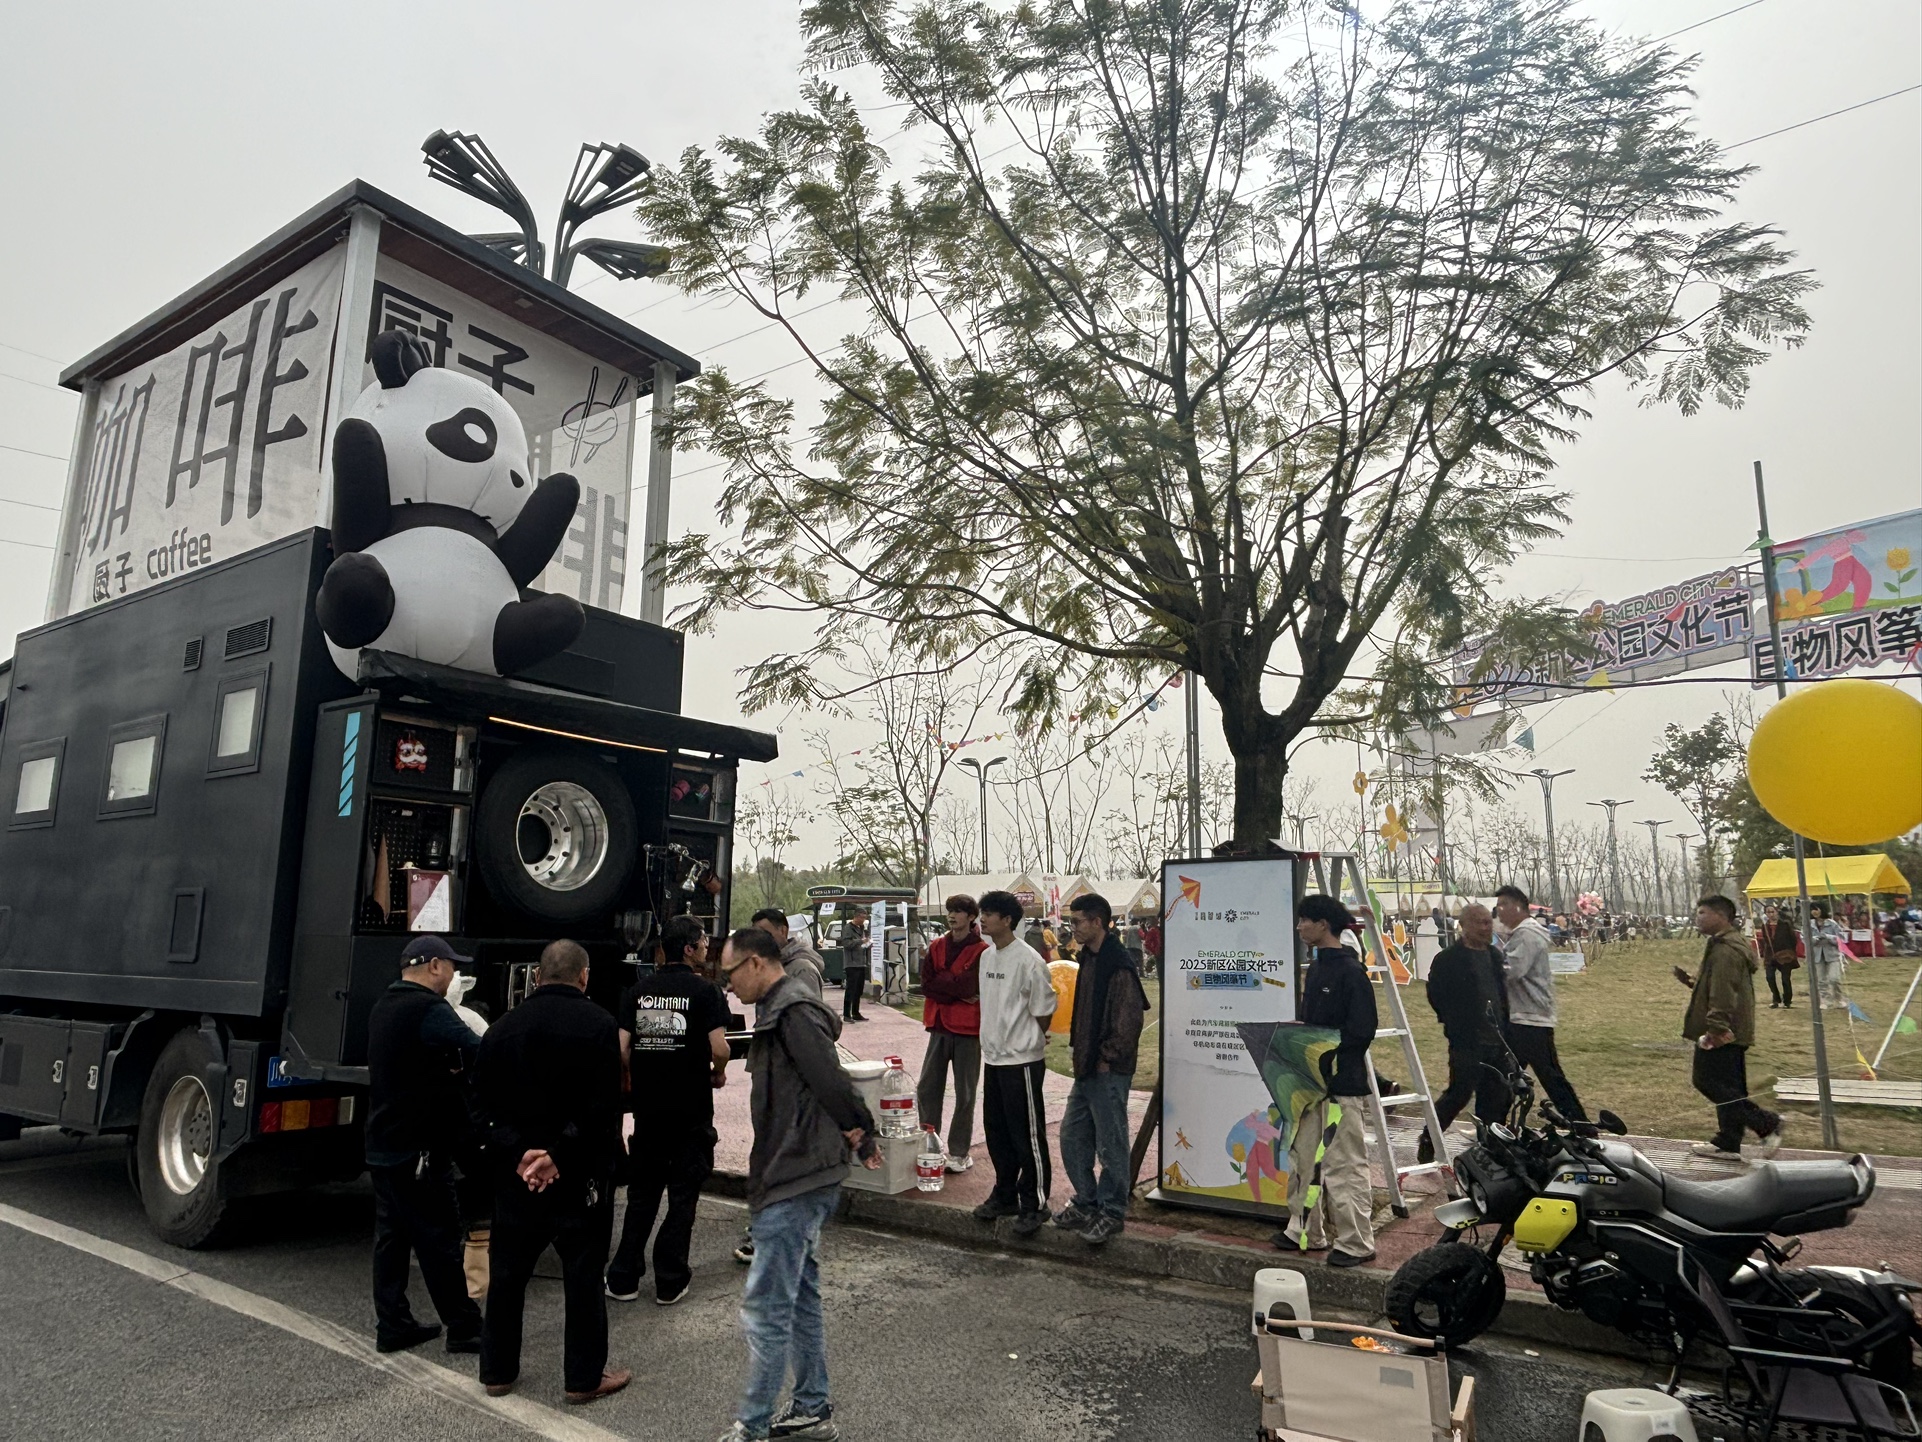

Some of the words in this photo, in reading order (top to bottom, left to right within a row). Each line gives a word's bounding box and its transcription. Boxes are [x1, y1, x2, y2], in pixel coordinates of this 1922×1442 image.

[92, 551, 133, 603] 厨子
[146, 526, 212, 580] coffee
[1603, 590, 1676, 624] EMERALD
[1679, 576, 1719, 602] CITY
[1180, 958, 1278, 972] 2025新区公园文化节
[1197, 950, 1236, 958] EMERALD
[1237, 950, 1257, 958] CITY
